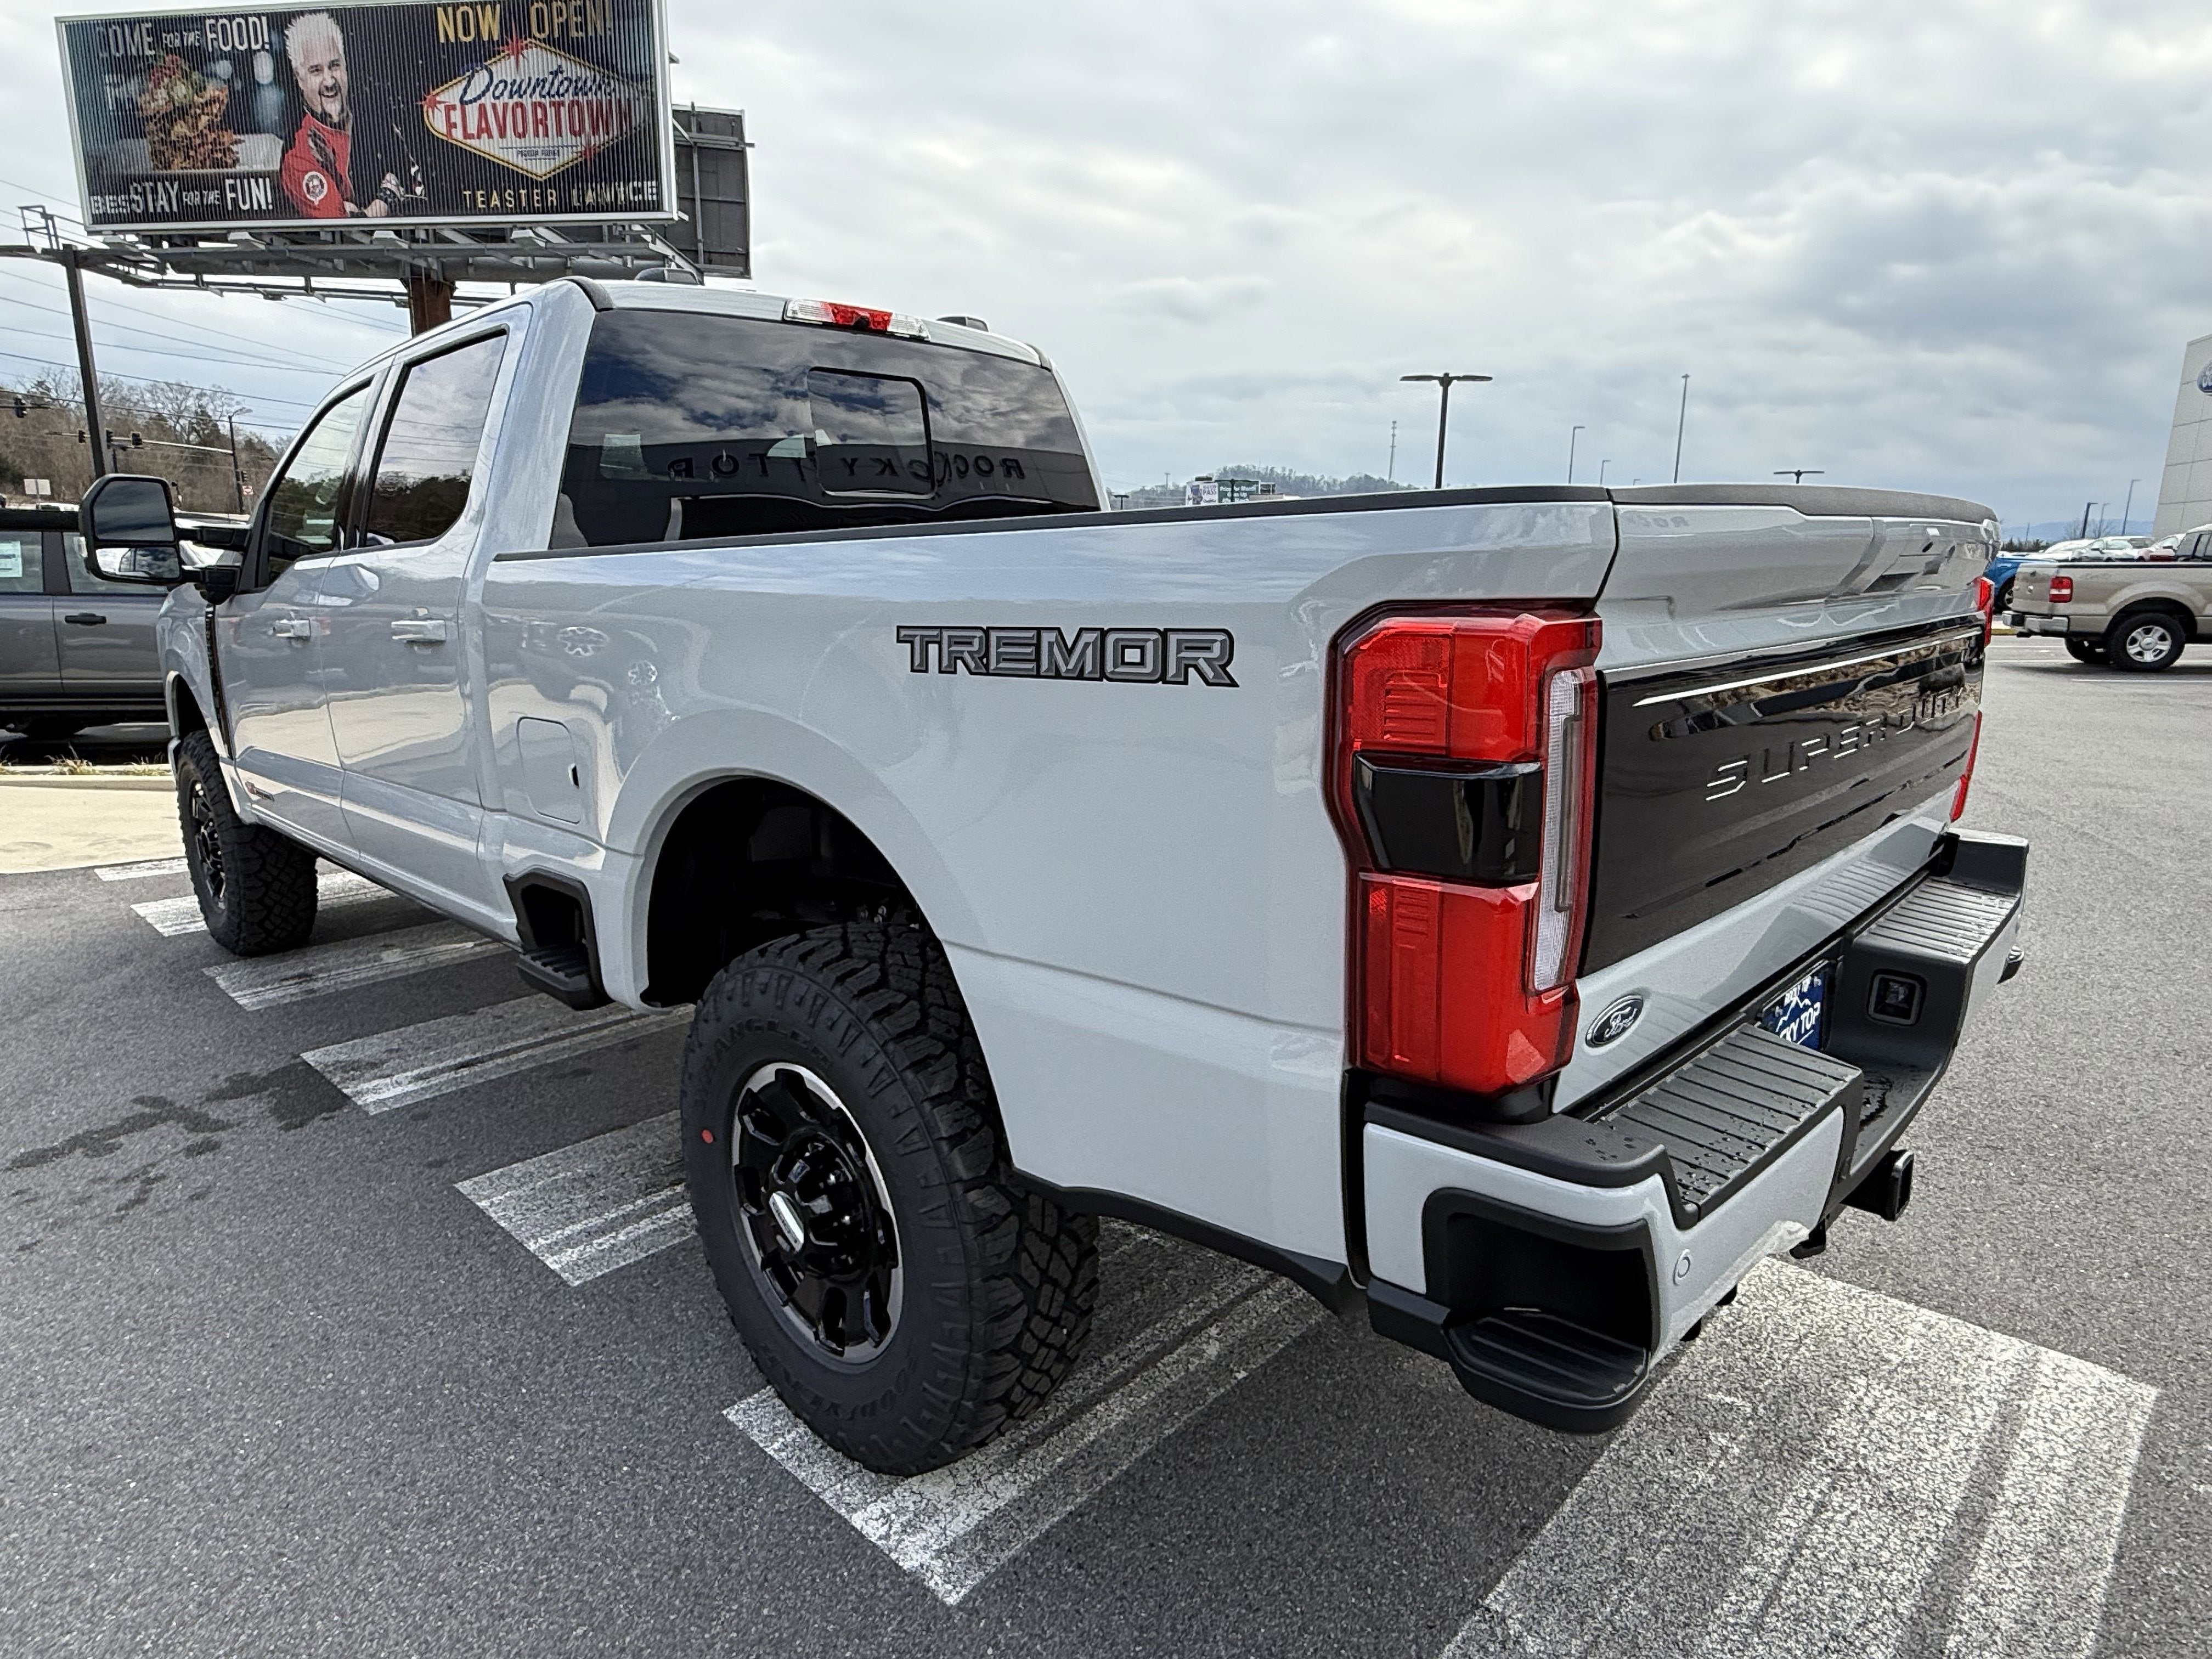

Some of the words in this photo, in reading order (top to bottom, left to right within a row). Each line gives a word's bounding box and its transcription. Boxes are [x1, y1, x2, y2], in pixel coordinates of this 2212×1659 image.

[182, 31, 201, 47] THE
[205, 16, 270, 52] FOOD!
[437, 5, 500, 43] NOW
[459, 63, 617, 105] Downtown
[444, 98, 631, 140] FLAVORTOWN
[130, 180, 179, 213] STAY
[224, 177, 273, 211] FUN!
[462, 189, 558, 208] TEASTER
[896, 625, 1240, 688] TREMOR
[1706, 711, 1888, 802] SUPER
[1801, 1002, 1821, 1034] TOP
